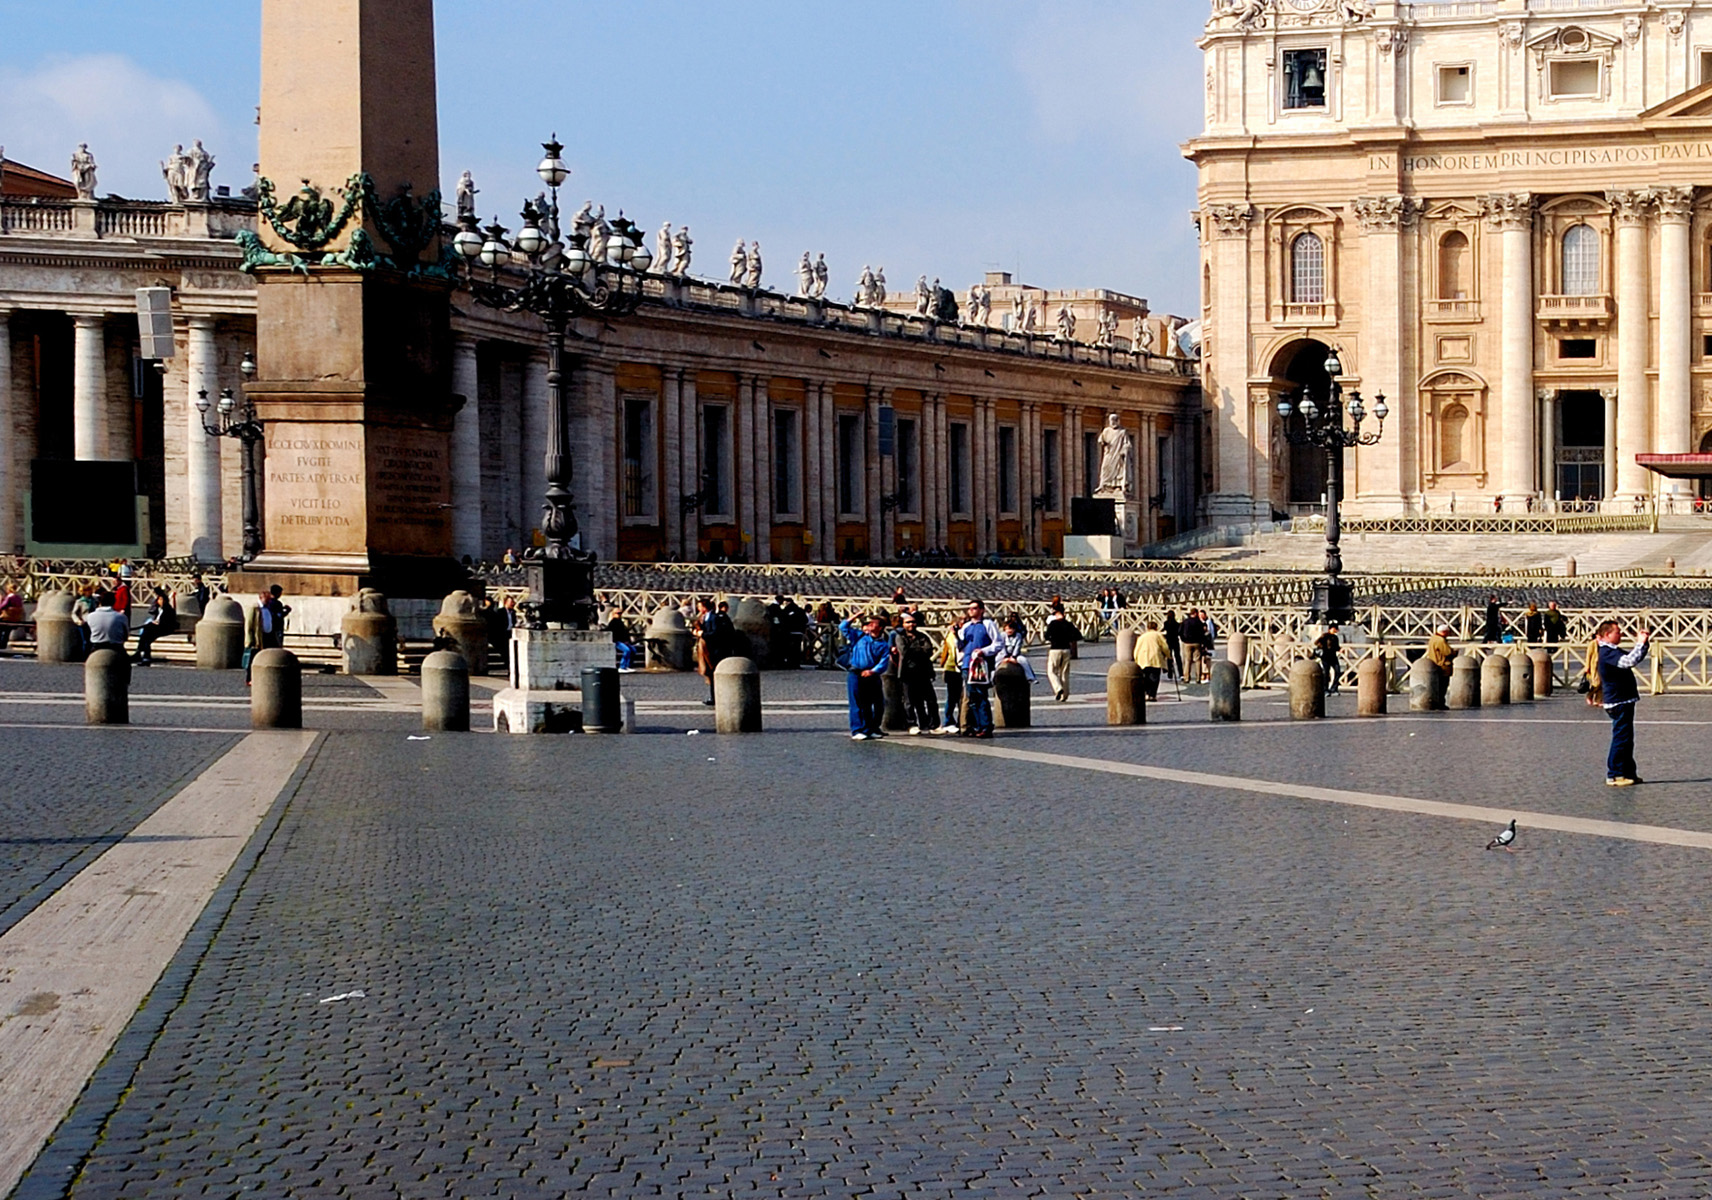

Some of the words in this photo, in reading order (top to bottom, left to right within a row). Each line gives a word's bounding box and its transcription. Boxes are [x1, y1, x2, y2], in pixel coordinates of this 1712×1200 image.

[1369, 155, 1391, 171] IN
[1403, 153, 1499, 172] HONOREM
[1500, 148, 1598, 167] PRINCIPIS
[1601, 147, 1660, 165] APOST
[270, 472, 306, 483] PARTES
[290, 498, 319, 509] VICIT
